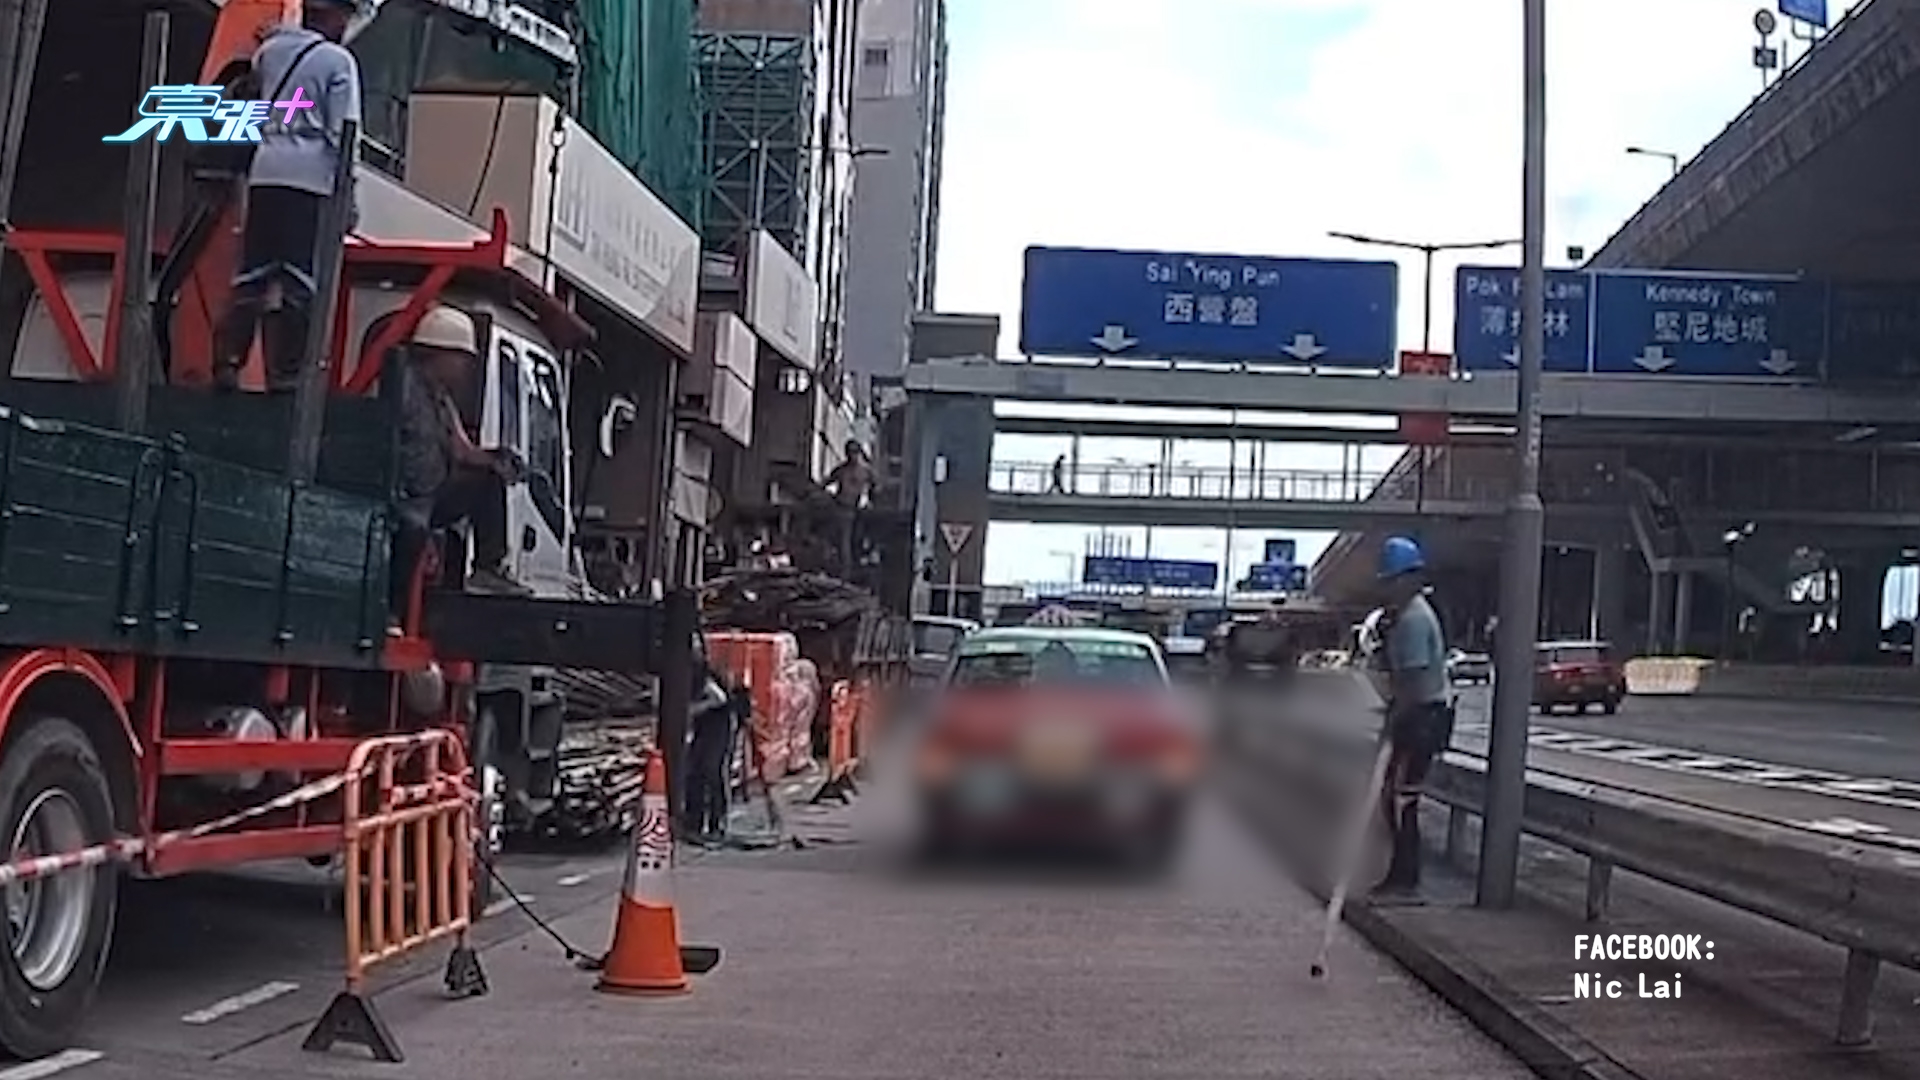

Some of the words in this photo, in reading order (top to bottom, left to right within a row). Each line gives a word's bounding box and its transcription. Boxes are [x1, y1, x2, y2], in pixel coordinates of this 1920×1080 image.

[1146, 261, 1178, 283] Sai
[1185, 261, 1231, 291] Ying
[1243, 265, 1280, 286] Pun
[1466, 276, 1502, 297] Pok
[1545, 280, 1585, 300] Lam
[1645, 283, 1720, 308] Kennedy
[1732, 285, 1776, 305] Town
[1654, 311, 1768, 343] 堅尼地城
